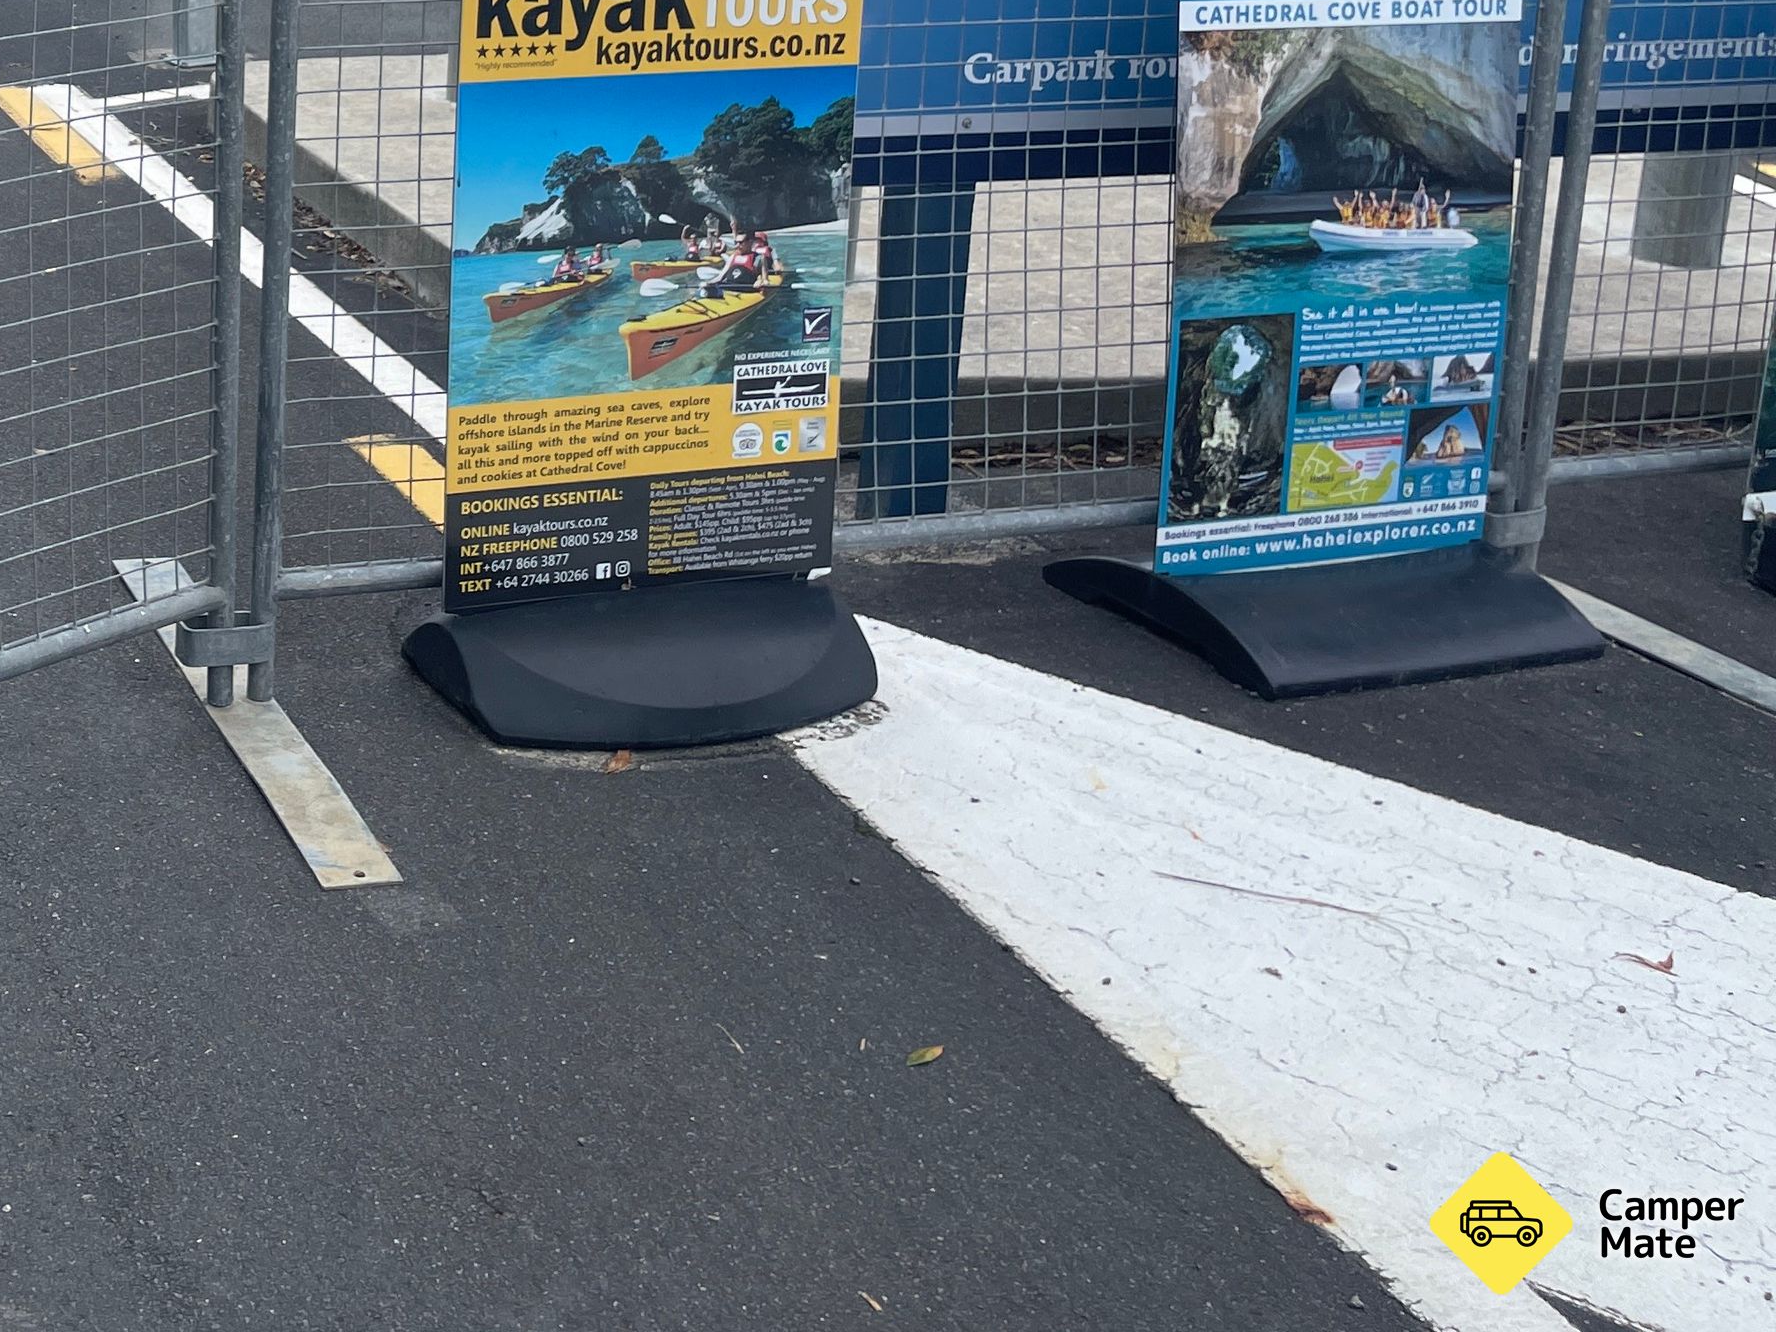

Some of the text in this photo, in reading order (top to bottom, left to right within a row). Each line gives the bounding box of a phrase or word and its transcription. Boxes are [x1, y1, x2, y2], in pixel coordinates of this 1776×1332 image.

[1196, 3, 1318, 25] CATHEDRAL
[1328, 1, 1381, 19] COVE
[1391, 0, 1444, 18] BOAT
[596, 32, 846, 70] kayaktours.co.nz
[964, 50, 1115, 92] Carpark
[1328, 306, 1337, 318] it
[1342, 305, 1354, 317] all
[1359, 306, 1368, 317] in
[748, 351, 789, 359] EXPERIENCE
[737, 361, 826, 377] CATHEDRAL COVE
[459, 396, 710, 426] Paddle through amazing sea caves, explore
[735, 396, 826, 412] KAYAK TOURS
[458, 410, 710, 440] offshore islands in the Marine Reserve and try
[458, 443, 490, 456] kayak
[496, 439, 532, 452] sailing
[539, 436, 563, 448] with
[569, 435, 587, 445] the
[592, 431, 619, 443] wind
[625, 431, 638, 441] on
[645, 428, 669, 443] your
[458, 439, 708, 471] all this and more topped off with cappuccinos
[457, 460, 626, 485] and cookies at Cathedral Cove!
[461, 488, 623, 514] BOOKINGS ESSENTIAL:
[461, 516, 608, 539] ONLINE kayaktours.co.nz
[1165, 527, 1206, 541] Bookings
[1298, 516, 1322, 526] 0800
[1343, 512, 1358, 522] 386
[1441, 501, 1457, 512] 866
[1459, 499, 1479, 510] 3910
[460, 529, 638, 557] NZ FREEPHONE 0800 529 258
[1162, 518, 1475, 565] Book online: www.haheiexplorer.co.nz
[516, 555, 537, 568] 866
[541, 553, 570, 567] 3877
[459, 569, 589, 592] TEXT +64 2744 30266
